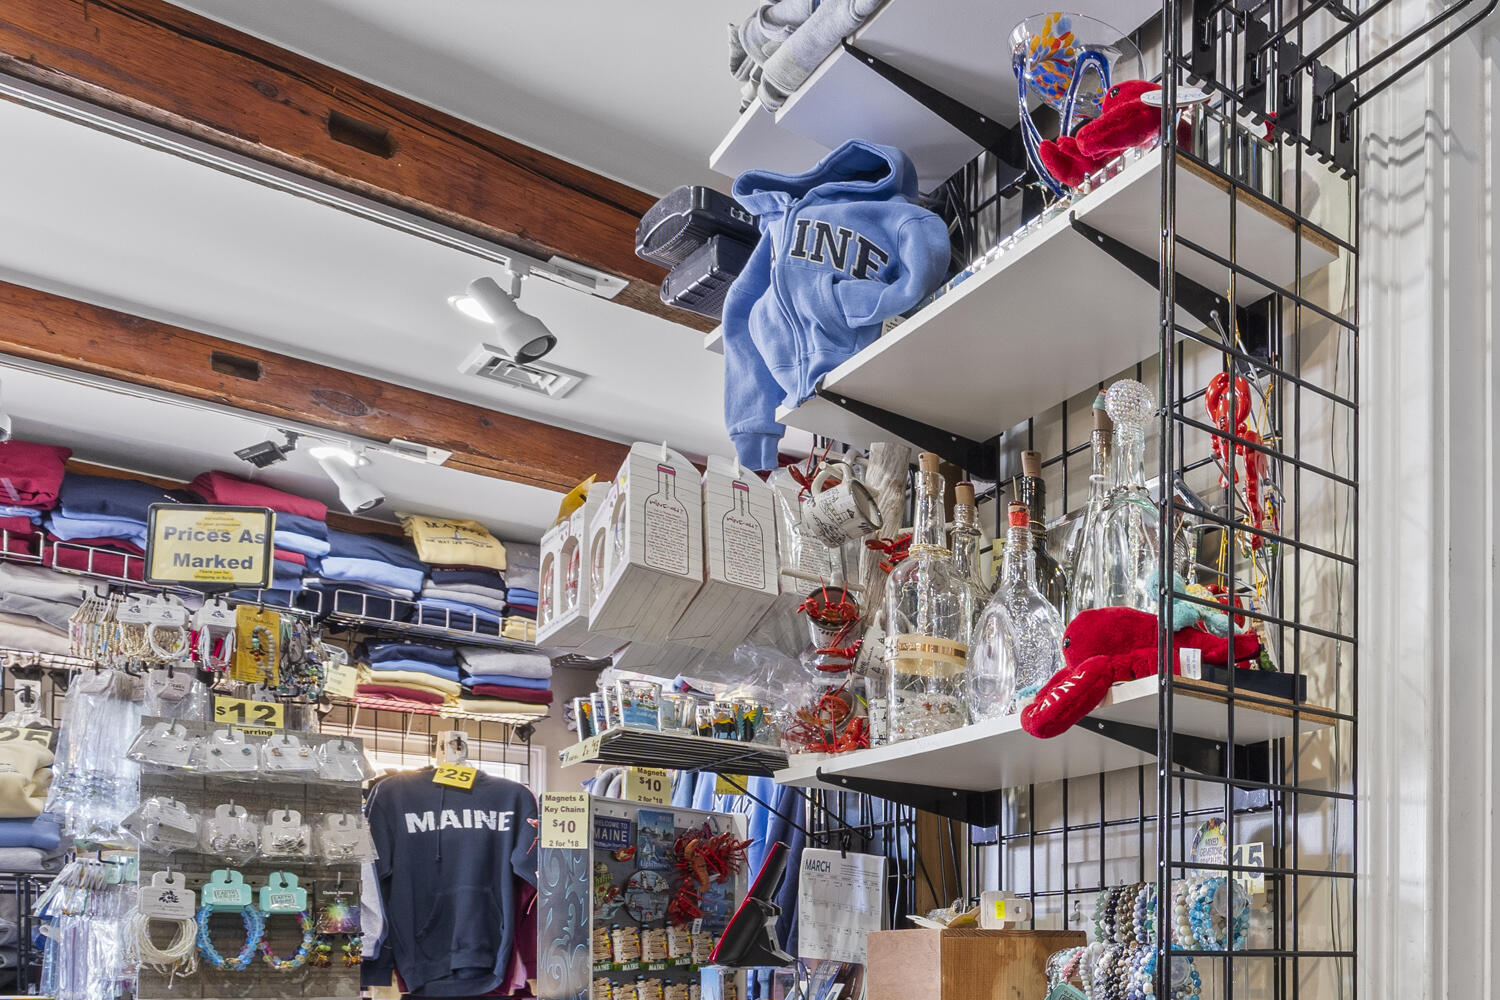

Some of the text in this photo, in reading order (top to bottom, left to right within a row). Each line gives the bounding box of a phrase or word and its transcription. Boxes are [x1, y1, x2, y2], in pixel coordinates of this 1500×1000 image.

[163, 526, 265, 545] Prices As
[173, 553, 253, 570] Marked
[216, 702, 277, 727] $12
[438, 767, 473, 783] $25
[637, 767, 667, 777] Magnets
[639, 776, 662, 792] $10
[545, 794, 585, 803] Magnets &
[544, 805, 585, 816] Key Chains
[404, 808, 515, 834] MAINE
[552, 819, 576, 834] $10
[594, 827, 628, 843] MAINE
[804, 859, 832, 873] MARCH
